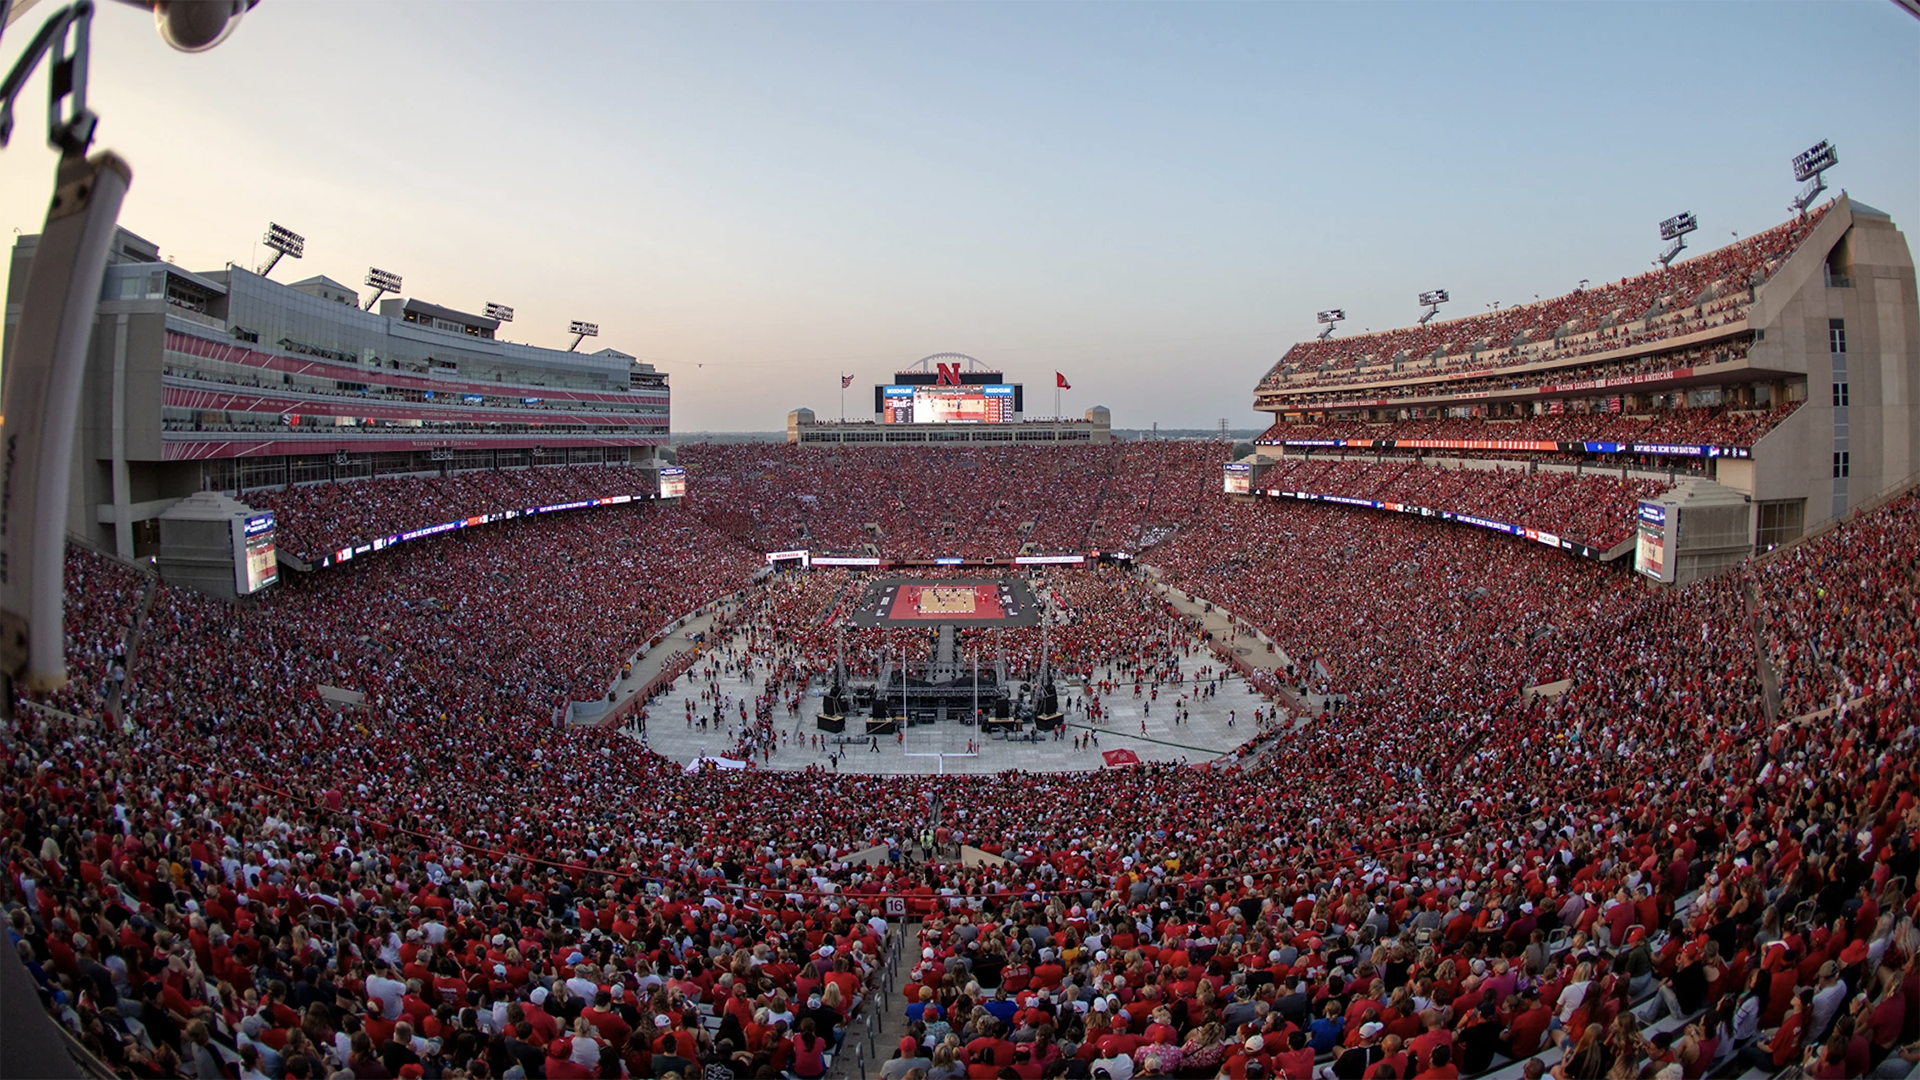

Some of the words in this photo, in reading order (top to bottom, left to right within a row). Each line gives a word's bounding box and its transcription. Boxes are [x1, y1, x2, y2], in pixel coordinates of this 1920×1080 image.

[936, 363, 961, 385] N
[1556, 383, 1573, 391] NATION
[1574, 381, 1595, 390] LEADING
[1607, 376, 1633, 386] ACADEMIC
[1634, 375, 1644, 383] ALL
[1645, 371, 1674, 382] AMERICANS
[1464, 440, 1478, 448] DAY
[1498, 441, 1540, 449] NEBRASKA
[888, 900, 903, 911] 16
